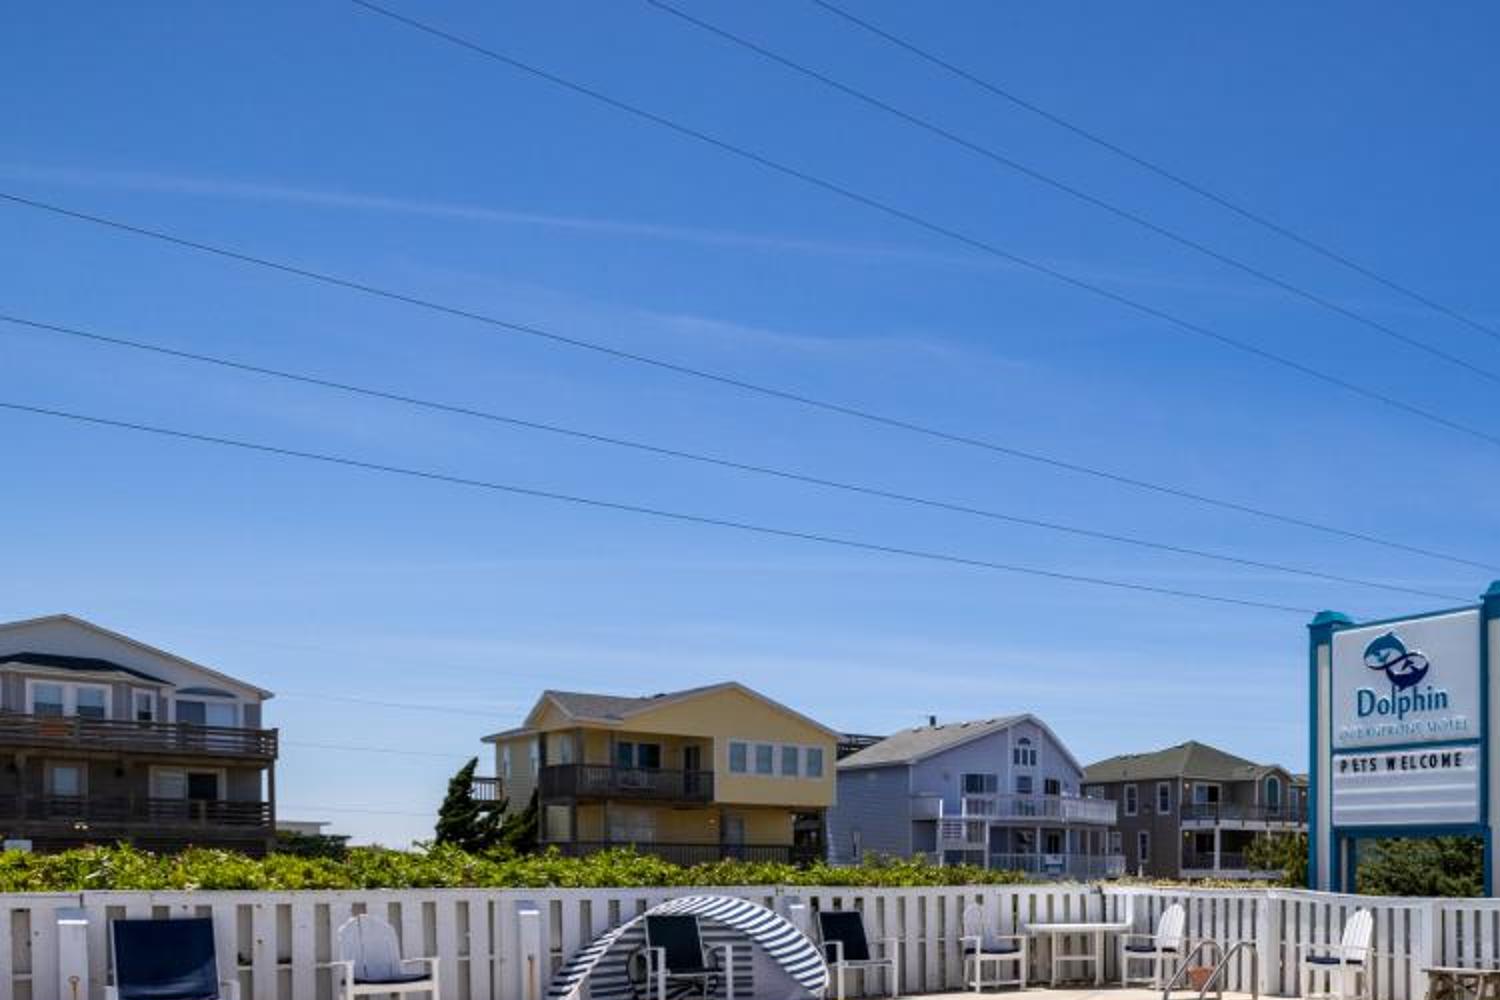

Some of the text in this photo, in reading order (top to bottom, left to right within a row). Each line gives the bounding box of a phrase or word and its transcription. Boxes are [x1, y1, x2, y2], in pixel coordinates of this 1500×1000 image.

[1357, 686, 1448, 720] Dolphin
[1339, 752, 1463, 773] PETS WELCOME
